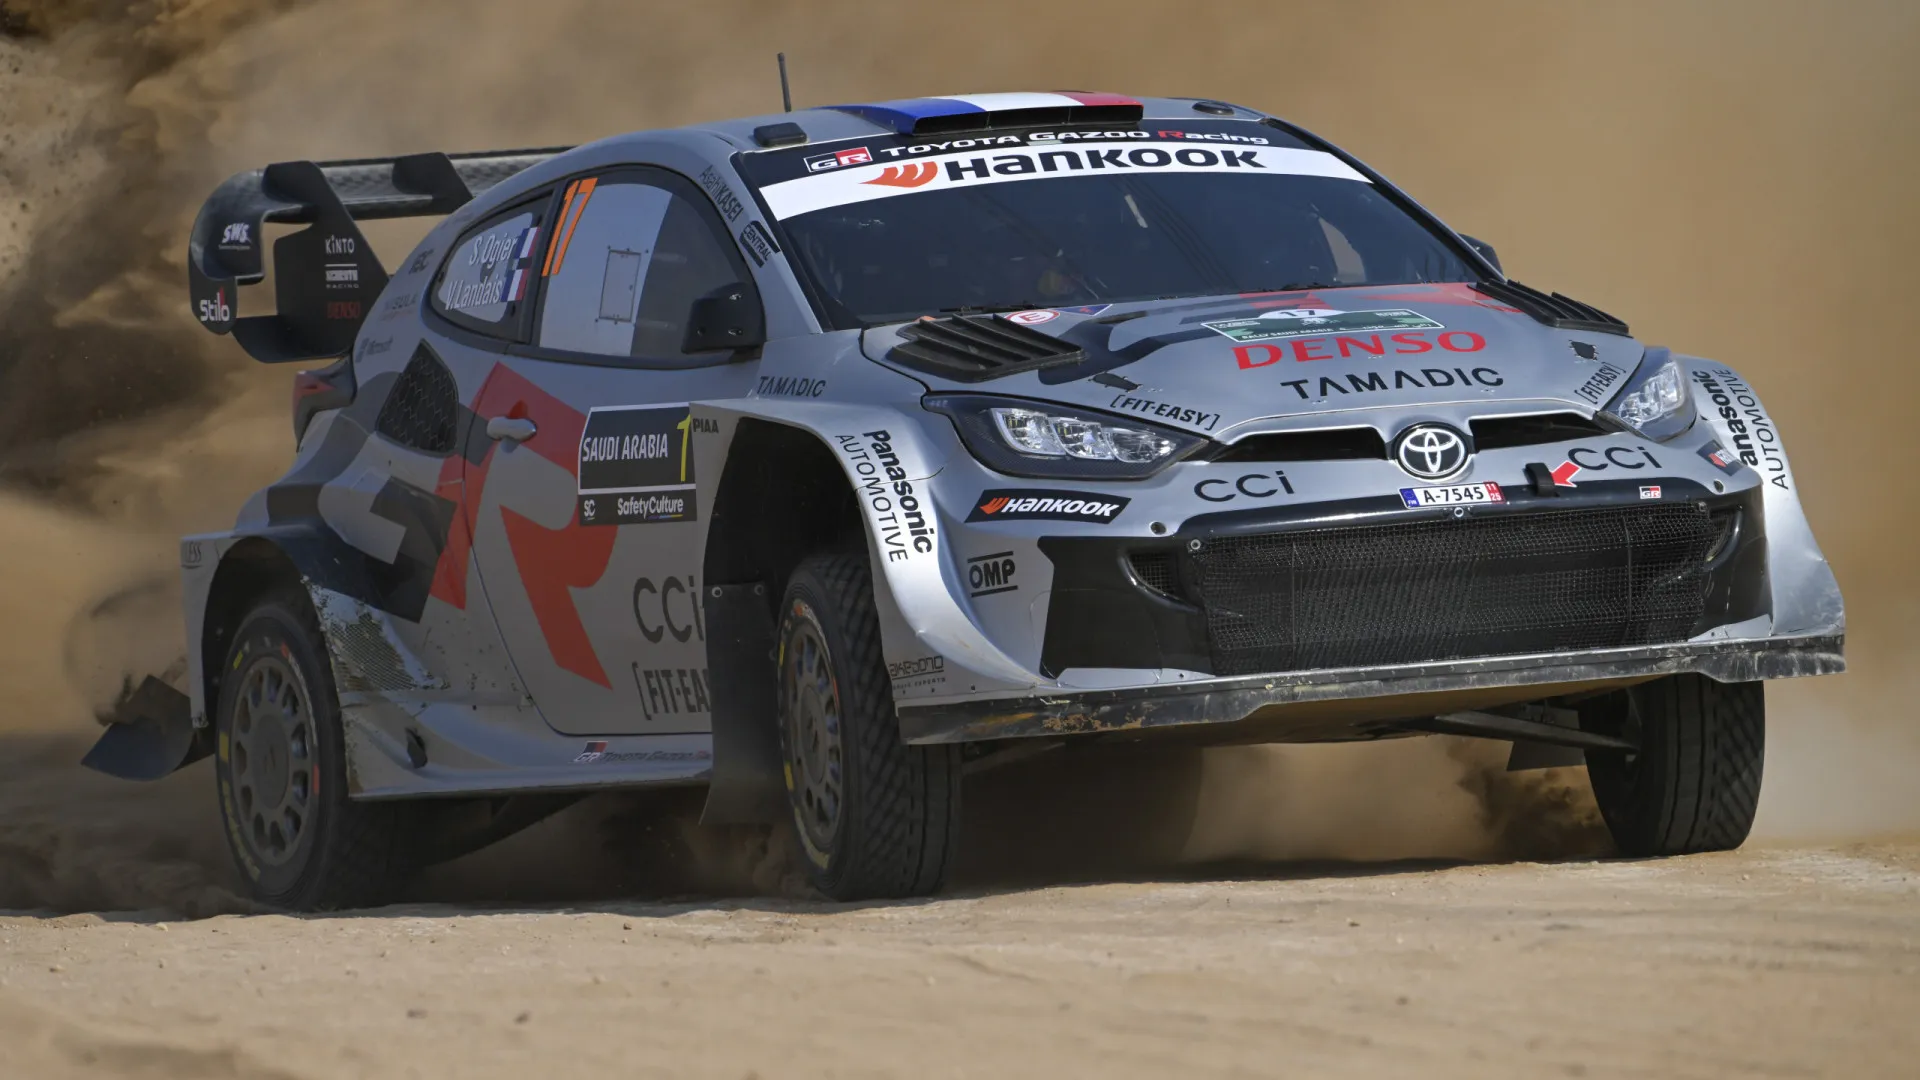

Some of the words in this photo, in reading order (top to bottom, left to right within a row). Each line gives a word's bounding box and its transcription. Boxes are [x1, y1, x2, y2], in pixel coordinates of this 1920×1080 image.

[880, 135, 1021, 157] TOYOTA
[1029, 131, 1150, 141] GAZOO
[1157, 129, 1270, 145] Racing
[810, 152, 873, 172] GR
[541, 177, 599, 277] 17
[743, 222, 772, 262] CENTRAL
[199, 289, 231, 322] Stilo
[1231, 331, 1487, 370] DENSO
[757, 375, 826, 398] TAMADIC
[1280, 367, 1504, 400] TAMADIC
[692, 418, 719, 434] PIAA
[1692, 370, 1758, 467] anasonic
[1712, 369, 1789, 490] AUTOMOTIVE
[582, 435, 620, 462] SAUDI
[621, 432, 668, 460] ARABIA
[834, 433, 909, 562] AUTOMOTIVE
[862, 429, 935, 554] Panasonic
[1423, 486, 1485, 503] A-7545
[1486, 483, 1498, 491] 11
[1490, 493, 1502, 501] 25
[617, 496, 684, 519] SafetyCulture
[968, 558, 1016, 589] OMP
